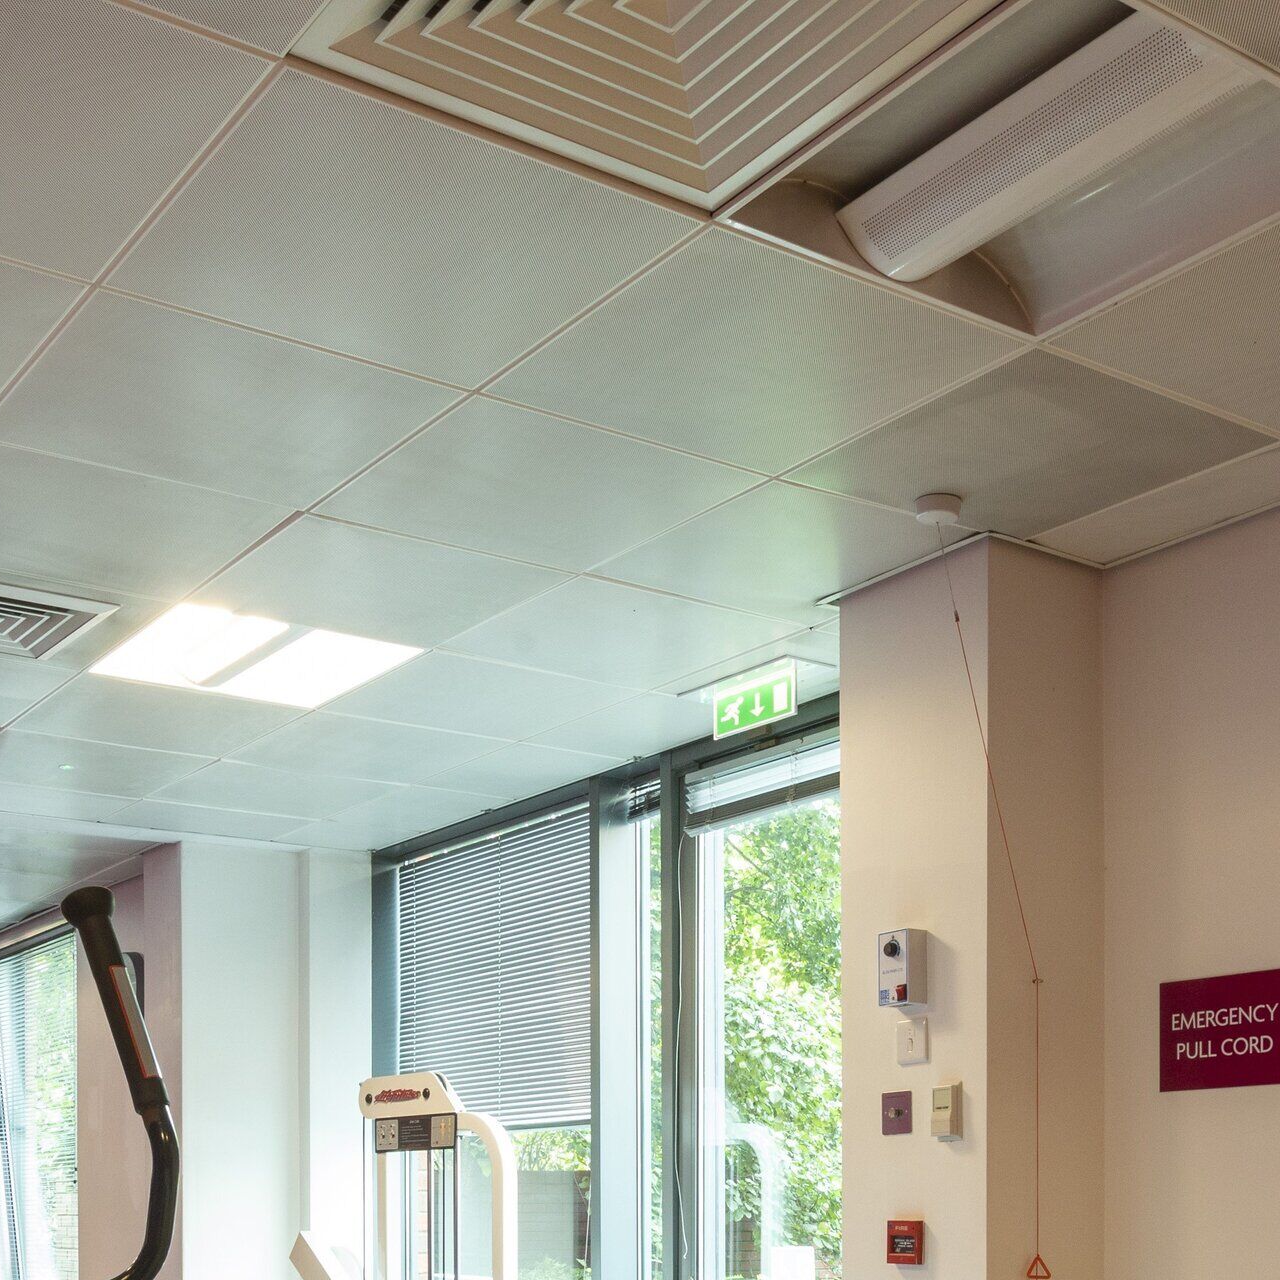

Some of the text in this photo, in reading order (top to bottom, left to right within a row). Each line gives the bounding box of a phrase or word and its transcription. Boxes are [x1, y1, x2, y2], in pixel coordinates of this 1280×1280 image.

[1171, 1002, 1279, 1031] EMERGENCY
[1176, 1035, 1274, 1060] PULL CORD
